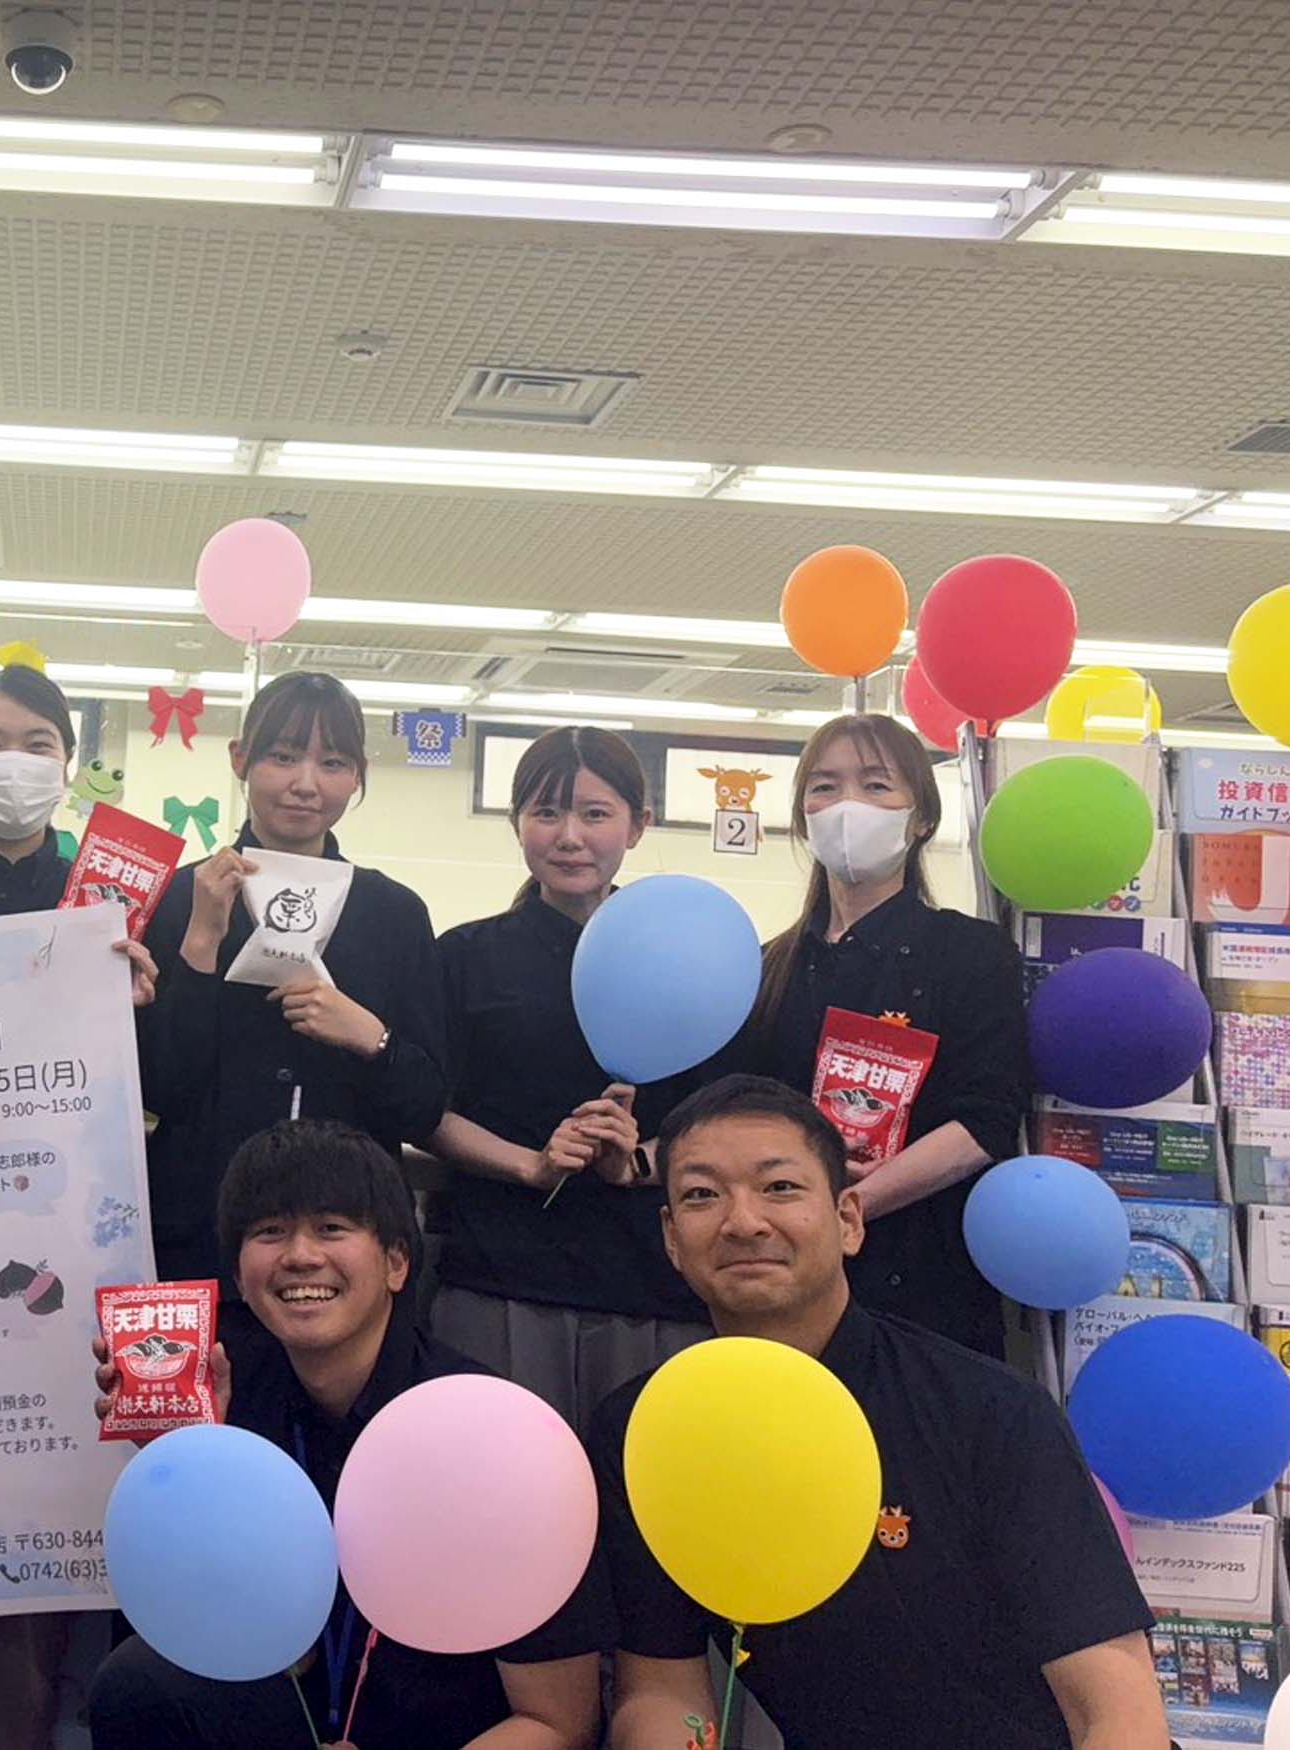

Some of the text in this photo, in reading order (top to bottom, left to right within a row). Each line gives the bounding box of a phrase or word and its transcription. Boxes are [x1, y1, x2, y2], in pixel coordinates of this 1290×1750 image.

[415, 721, 444, 750] 祭
[1218, 779, 1288, 803] 投資信
[726, 818, 747, 847] 2
[87, 848, 157, 894] 天津甘栗
[827, 1053, 910, 1095] 天津甘栗
[113, 1302, 200, 1333] 天津甘栗
